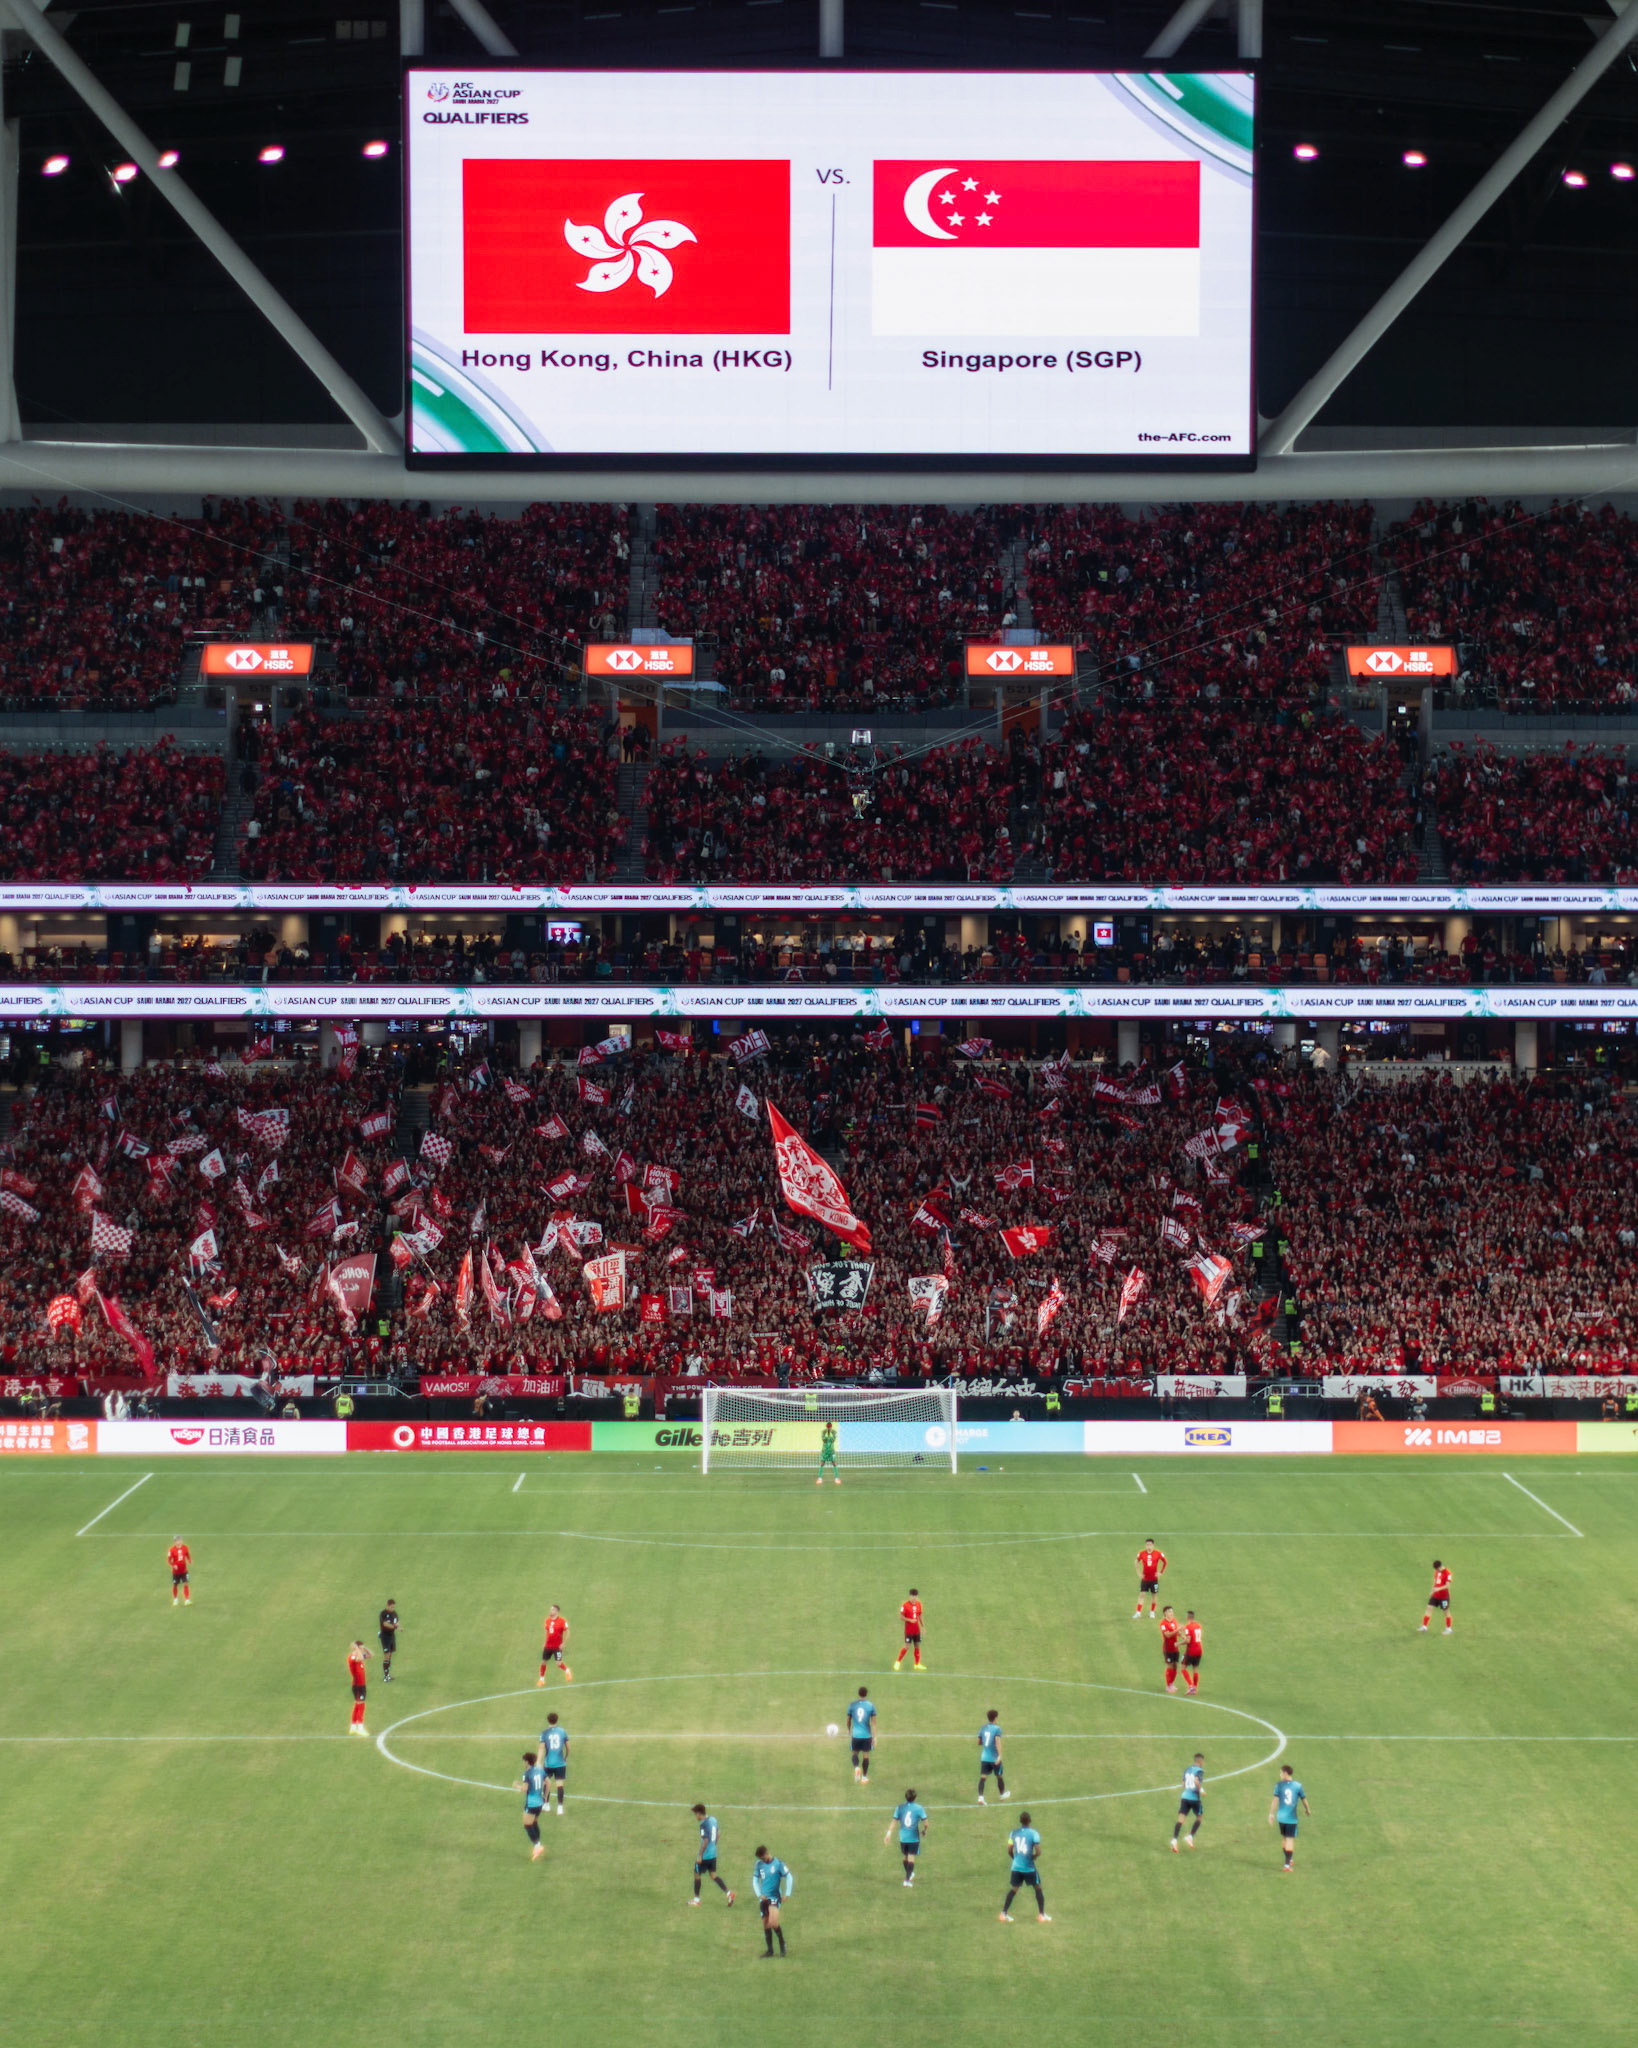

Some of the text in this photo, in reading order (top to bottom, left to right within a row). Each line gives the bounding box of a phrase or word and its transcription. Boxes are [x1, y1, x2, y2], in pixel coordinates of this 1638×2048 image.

[453, 90, 521, 98] ASIAN CUP
[423, 112, 530, 124] QUALIFIERS
[462, 349, 793, 371] Hong Kong, China (HKG)
[922, 351, 1142, 372] Singapore (SGP)
[264, 660, 293, 670] HSBC
[644, 660, 674, 670] HSBC
[1024, 661, 1053, 671] HSBC
[84, 997, 112, 1005] ASIAN
[114, 997, 133, 1005] CUP
[194, 997, 247, 1005] QUALIFIERS
[288, 997, 316, 1005] ASIAN
[318, 997, 337, 1005] CUP
[398, 998, 450, 1006] QUALIFIERS
[491, 998, 519, 1006] ASIAN
[521, 998, 541, 1006] CUP
[601, 998, 654, 1006] QUALIFIERS
[695, 998, 723, 1006] ASIAN
[725, 998, 744, 1006] CUP
[804, 998, 857, 1006] QUALIFIERS
[898, 998, 926, 1006] ASIAN
[928, 998, 947, 1006] CUP
[1008, 998, 1060, 1006] QUALIFIERS
[1101, 998, 1129, 1006] ASIAN
[1131, 998, 1151, 1006] CUP
[1211, 999, 1263, 1007] QUALIFIERS
[1304, 999, 1332, 1007] ASIAN
[1334, 999, 1353, 1007] CUP
[1414, 999, 1467, 1007] QUALIFIERS
[1507, 999, 1535, 1007] ASIAN
[1537, 999, 1557, 1007] CUP
[425, 1382, 470, 1393] VAMOS!!
[1509, 1379, 1535, 1392] HK
[173, 1429, 202, 1439] NISSIN
[209, 1427, 275, 1446] 日清食品
[1189, 1433, 1228, 1441] IKEA
[857, 1707, 864, 1722] 9
[548, 1734, 560, 1749] 13
[984, 1732, 991, 1747] 7
[534, 1774, 542, 1790] 11
[1284, 1789, 1292, 1805] 3
[904, 1811, 912, 1827] 6
[1014, 1837, 1028, 1854] 14
